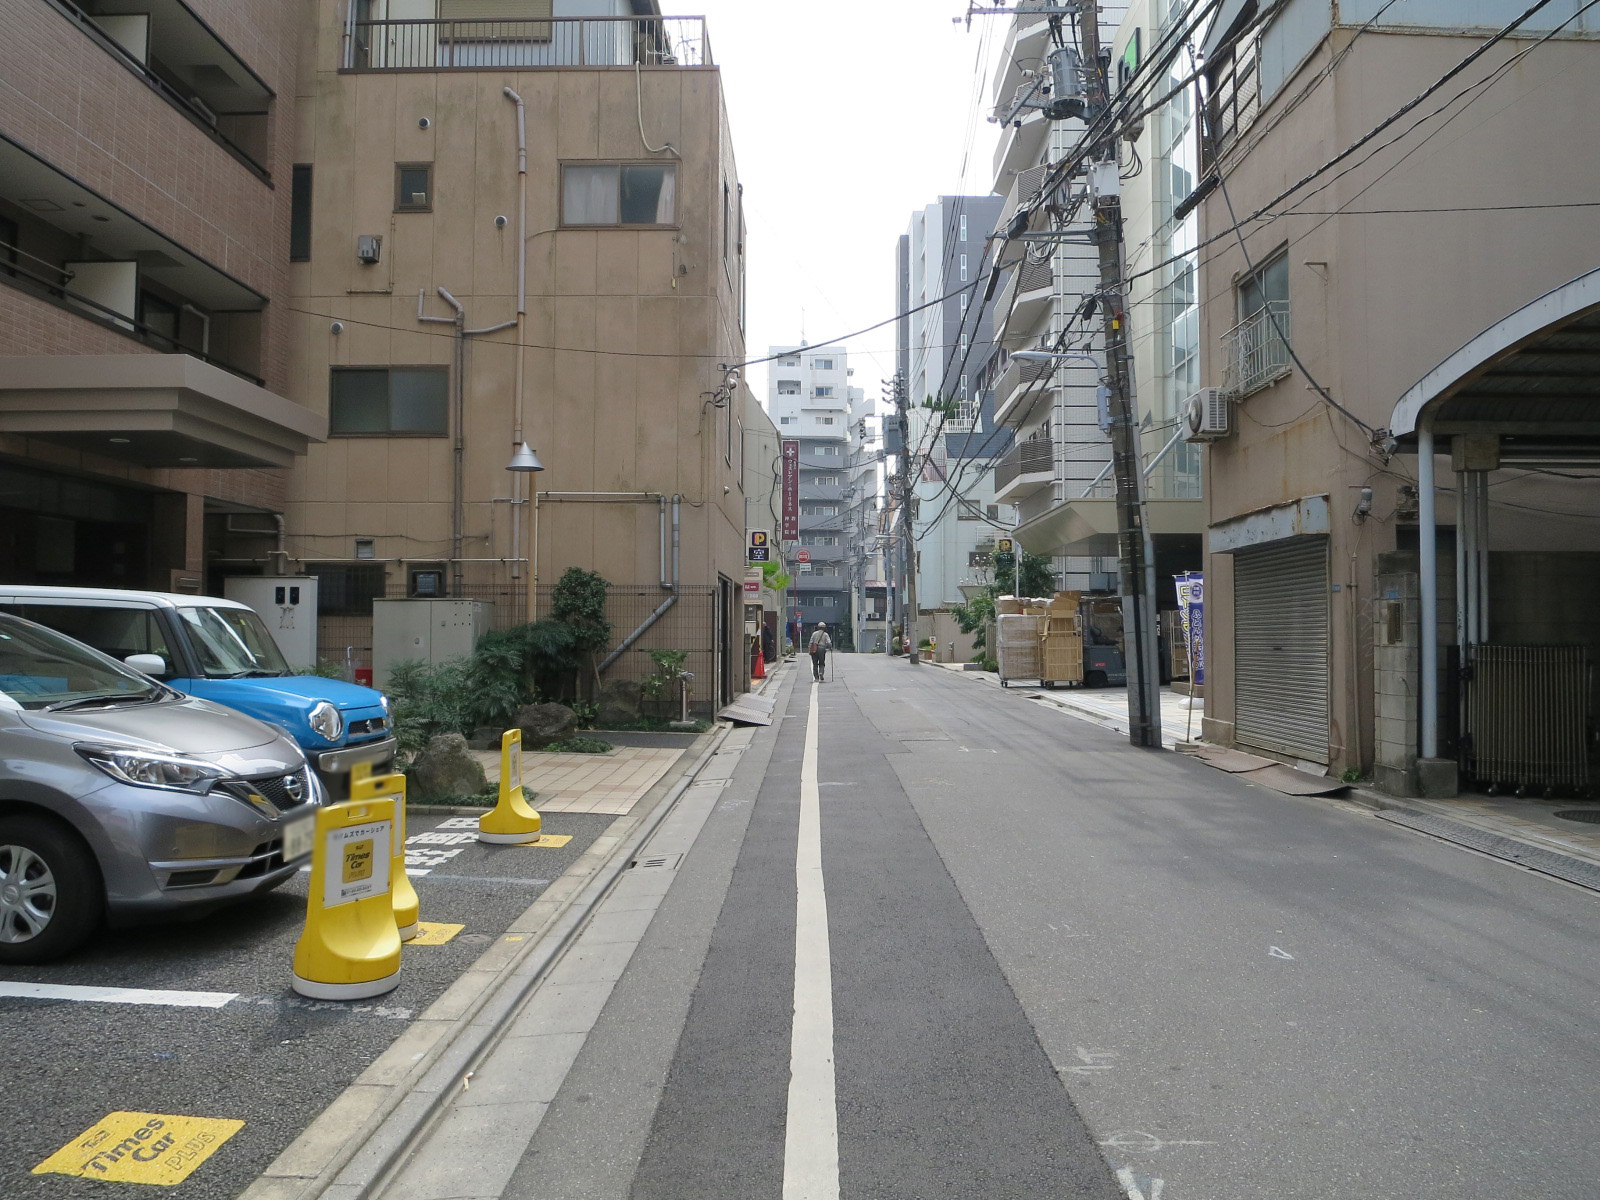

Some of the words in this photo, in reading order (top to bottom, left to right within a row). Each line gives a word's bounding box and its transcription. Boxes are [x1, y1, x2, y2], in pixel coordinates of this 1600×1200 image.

[754, 533, 765, 545] P
[753, 549, 765, 559] 空
[345, 852, 370, 862] Times
[350, 861, 364, 869] Car
[81, 1118, 165, 1173] Times
[131, 1132, 176, 1162] Car
[165, 1131, 216, 1170] PLUS
